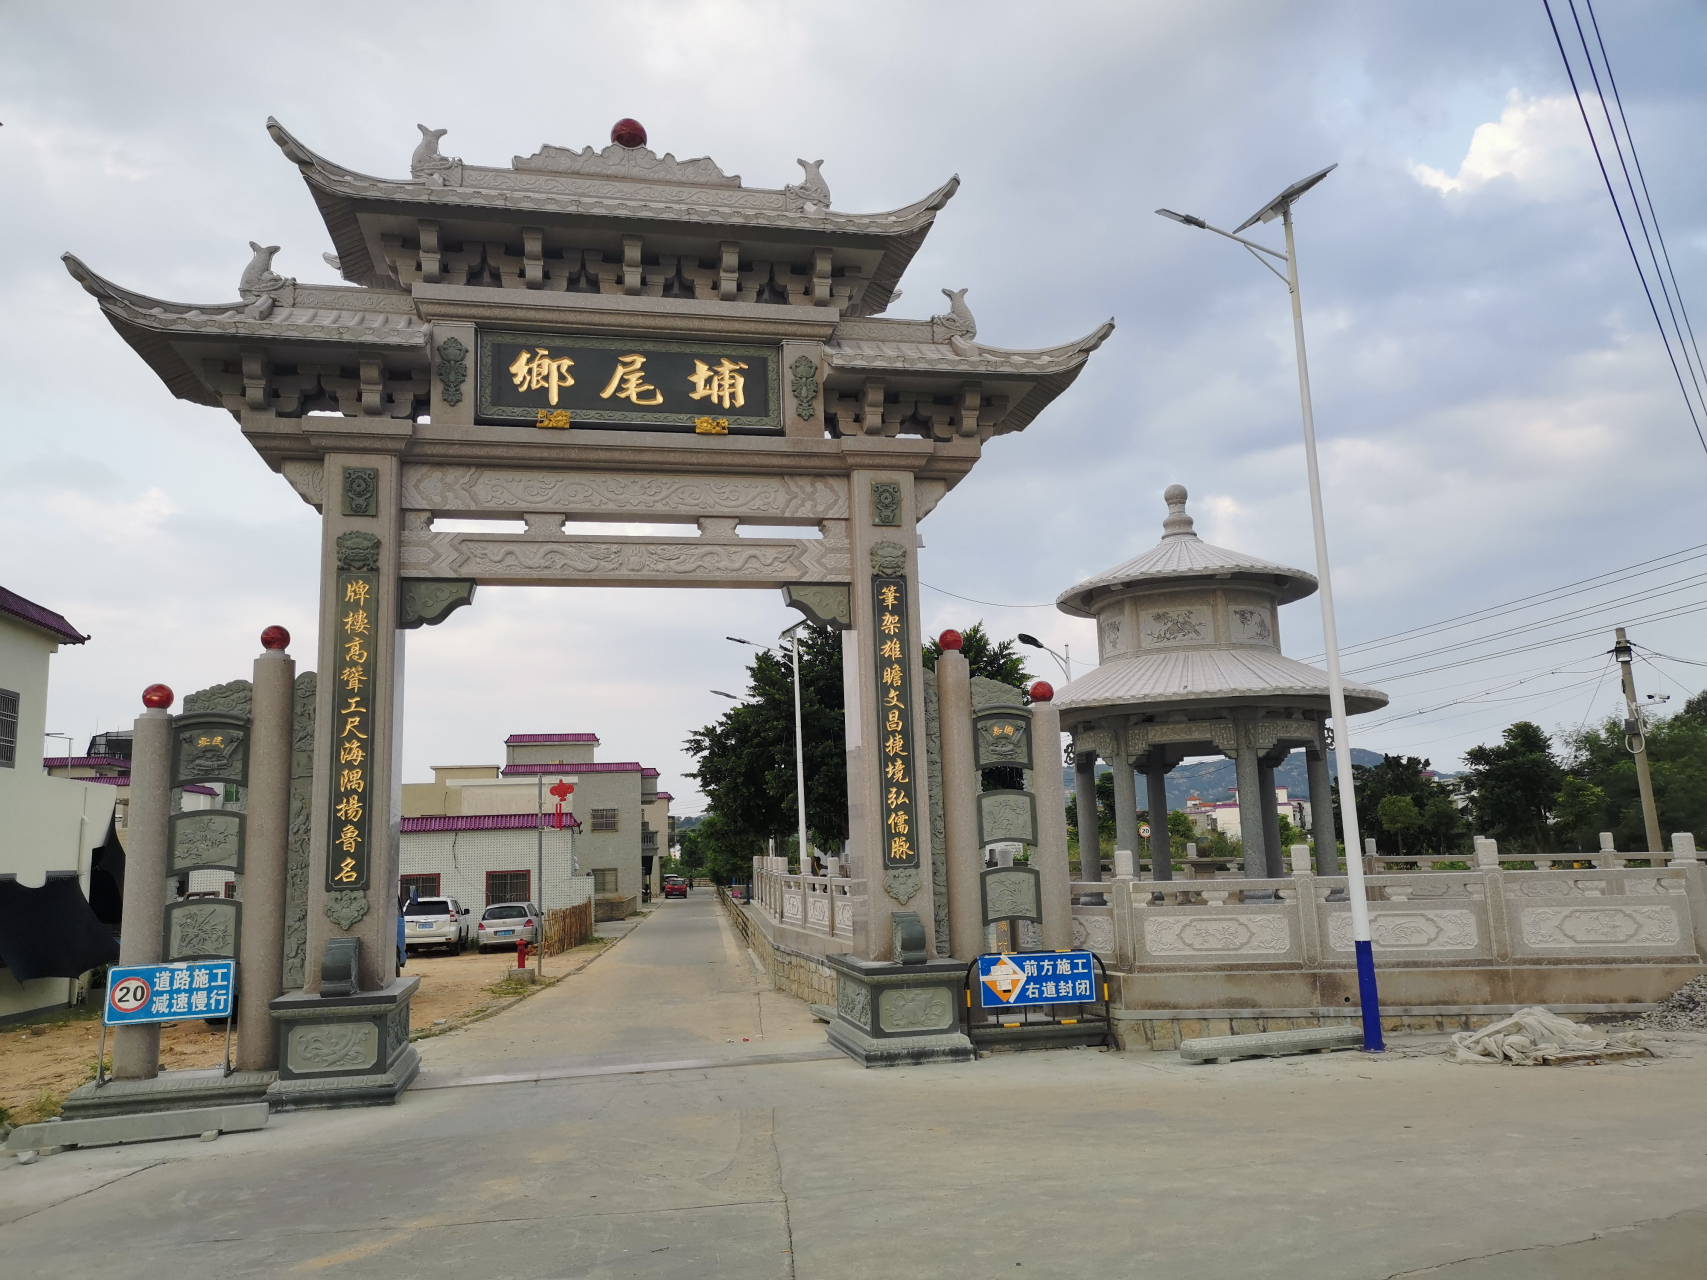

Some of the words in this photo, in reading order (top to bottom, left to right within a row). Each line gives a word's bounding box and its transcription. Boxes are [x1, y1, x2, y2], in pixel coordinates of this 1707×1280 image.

[1022, 958, 1089, 977] 前方施工
[153, 968, 228, 991] 道路施工
[1025, 979, 1090, 999] 右道封闭
[117, 984, 146, 1004] 20
[152, 990, 227, 1014] 减速慢行
